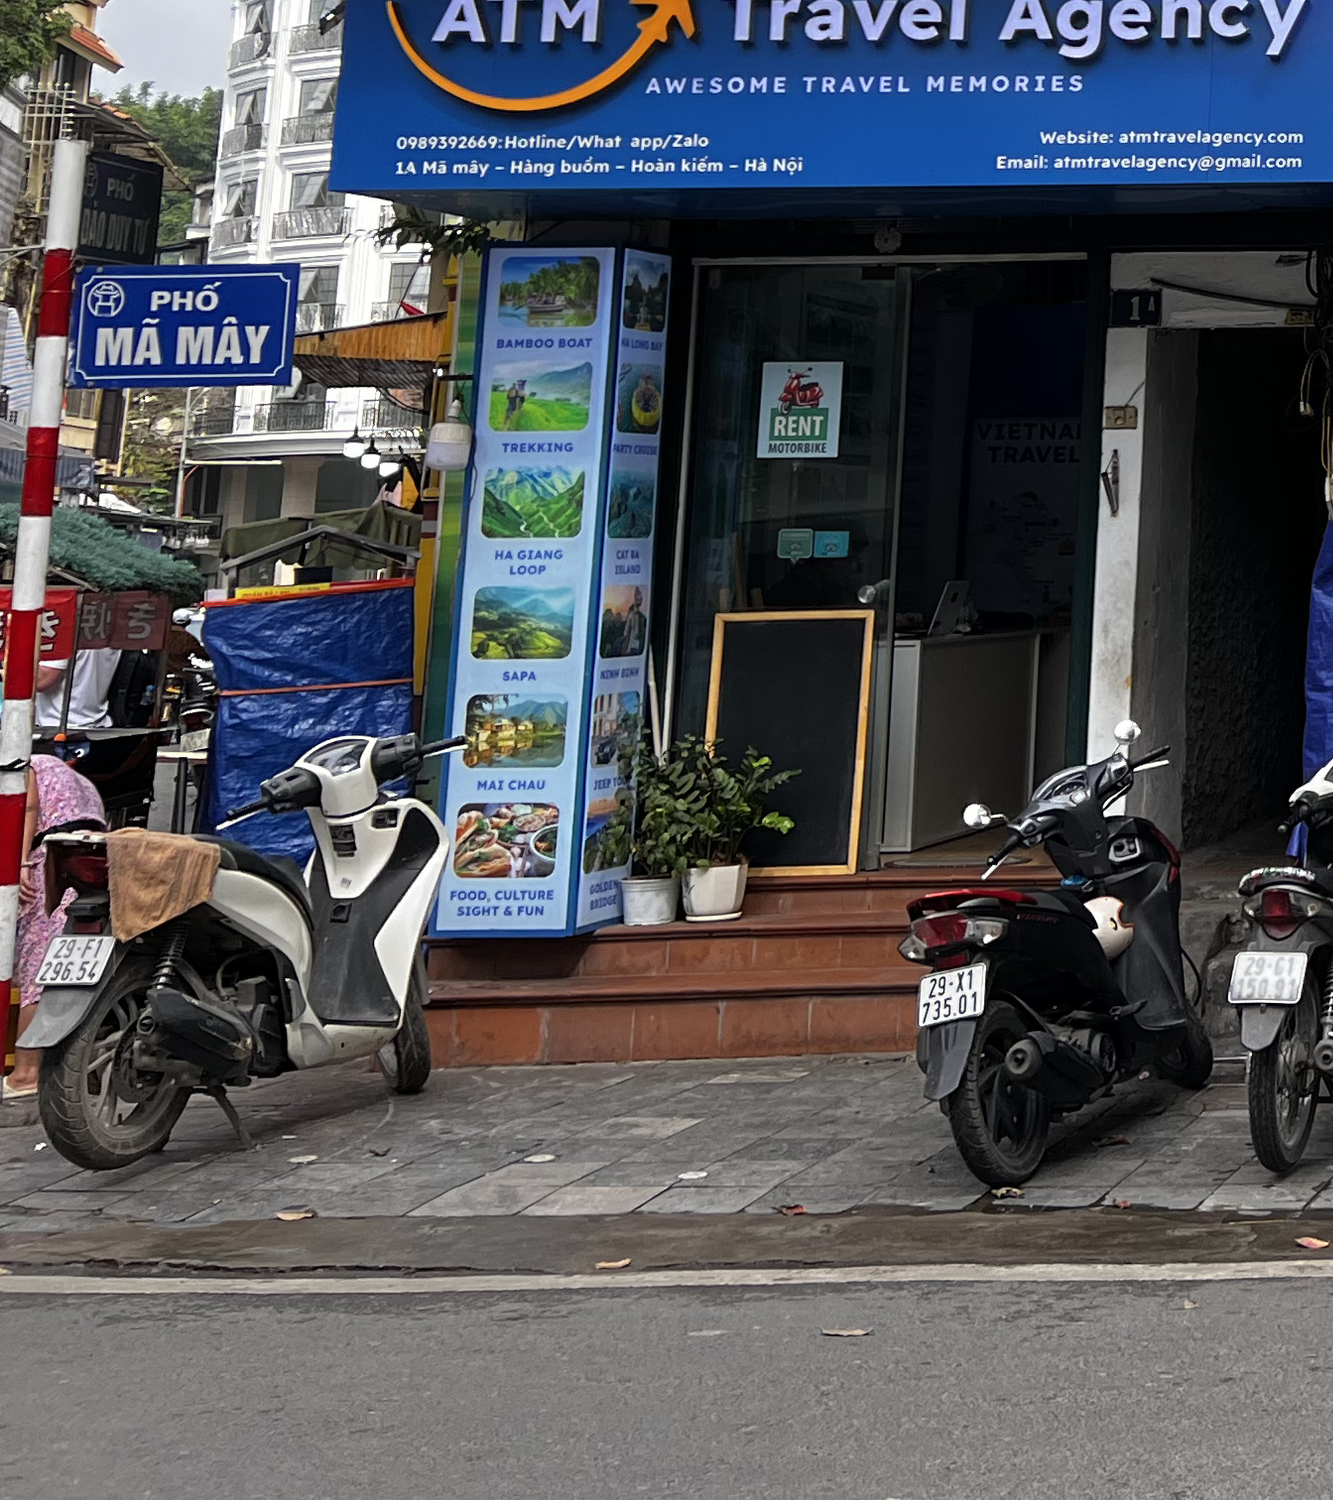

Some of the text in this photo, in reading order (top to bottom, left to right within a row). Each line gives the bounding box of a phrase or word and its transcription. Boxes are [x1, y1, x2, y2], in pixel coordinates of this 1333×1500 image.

[645, 75, 1085, 95] AWESOME TRAVEL MEMORIES
[630, 133, 709, 153] app/Zalo
[1039, 130, 1304, 148] Website: atmtravelagency.com
[395, 161, 417, 176] 1A
[423, 160, 448, 175] Mã
[453, 160, 490, 179] mây
[681, 155, 724, 174] kiếm
[744, 158, 766, 174] Hà
[772, 156, 803, 176] Nội
[996, 154, 1303, 173] Email: atmtravelagency@gmail.com
[106, 173, 136, 202] PHỐ
[150, 281, 223, 312] PHỐ
[1129, 295, 1156, 321] 1A
[94, 316, 271, 367] MÃ MÂY
[496, 337, 593, 350] BAMBOO BOAT
[621, 337, 663, 352] HA LONG BAY
[773, 415, 825, 437] RENT
[978, 422, 1082, 441] VIETNA
[502, 442, 574, 453] TREKKING
[613, 443, 633, 454] PARTY
[767, 441, 828, 454] MOTORBIKE
[988, 445, 1082, 464] TRAVEL
[494, 550, 563, 561] HA GIANG
[509, 564, 546, 576] LOOP
[614, 564, 641, 576] ISLAND
[502, 671, 537, 682] SAPA
[600, 667, 640, 679] NINH BINH
[476, 779, 546, 791] MAI CHAU
[450, 889, 554, 903] FOOD, CULTURE
[457, 905, 545, 917] SIGHT & FUN
[53, 938, 104, 959] 29-F1
[39, 960, 99, 982] 296.54
[928, 969, 974, 1000] 29-X1
[922, 991, 978, 1025] 735.01
